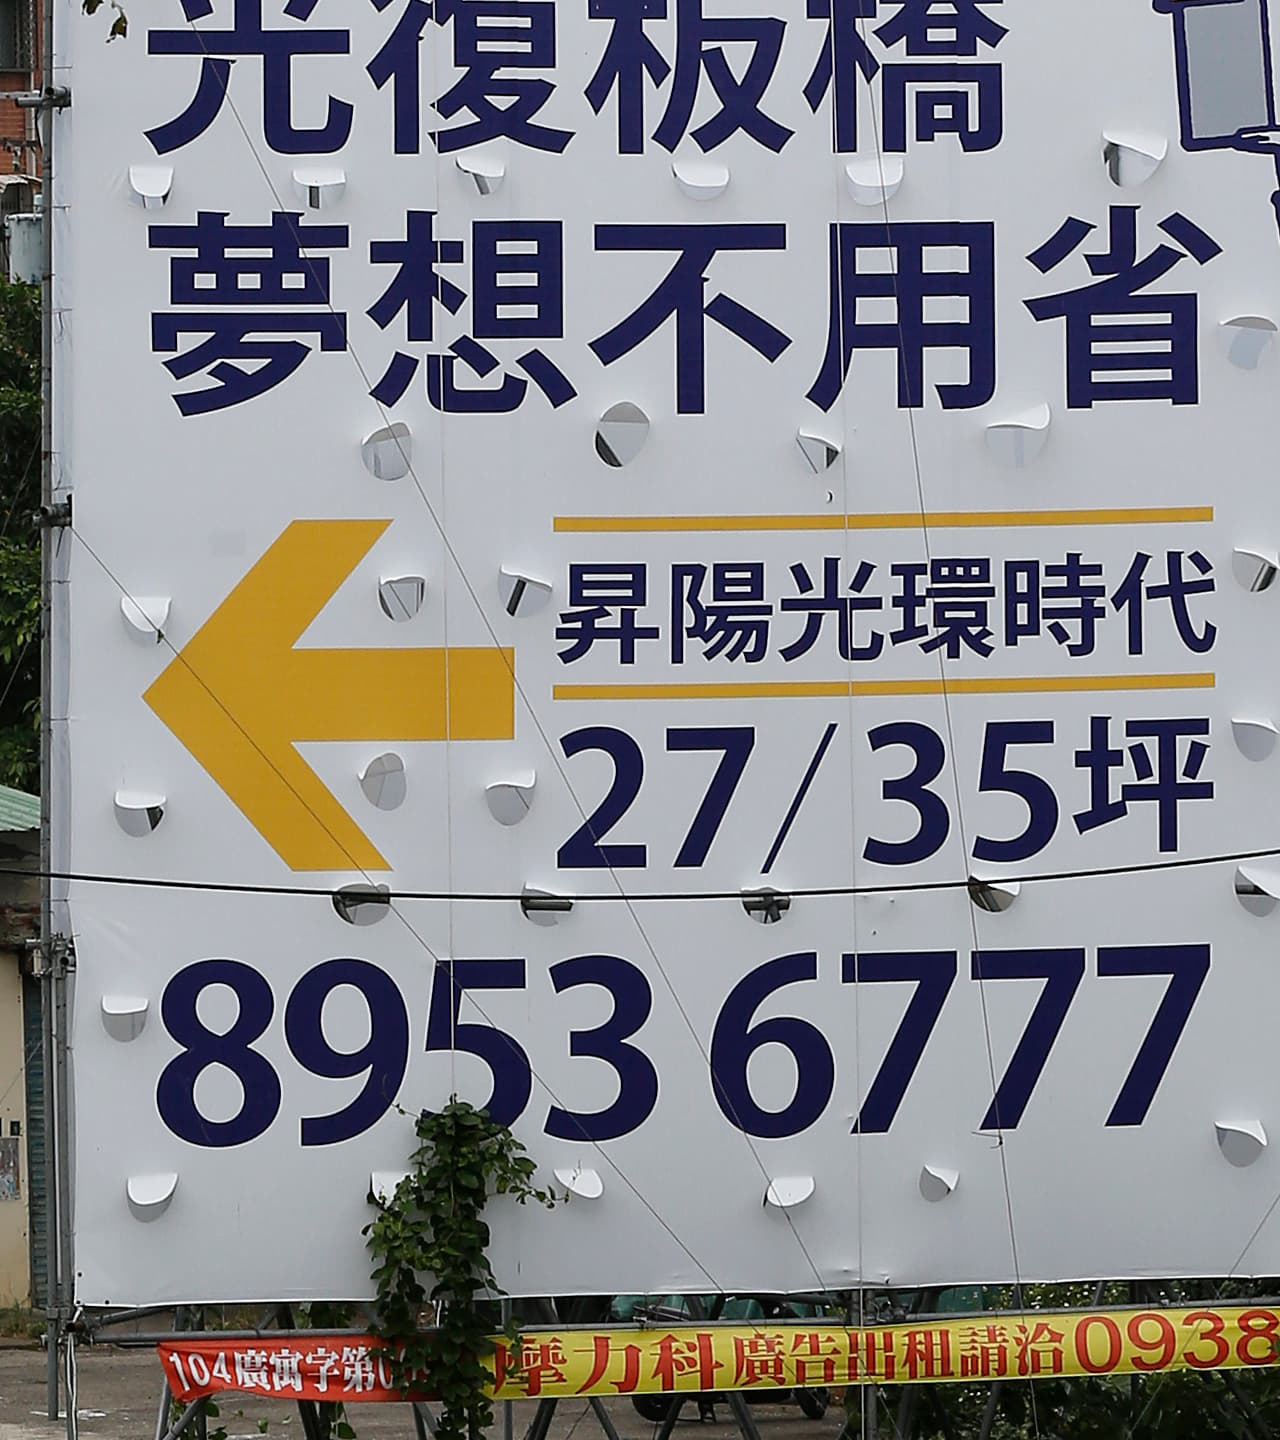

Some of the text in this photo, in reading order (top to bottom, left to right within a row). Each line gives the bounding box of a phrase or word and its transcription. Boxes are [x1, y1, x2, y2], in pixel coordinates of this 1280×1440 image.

[147, 206, 1222, 416] 夢想不用省
[555, 551, 1217, 664] 昇陽光環時代
[556, 716, 1214, 873] 27/35坪
[155, 944, 1211, 1148] 8953 6777
